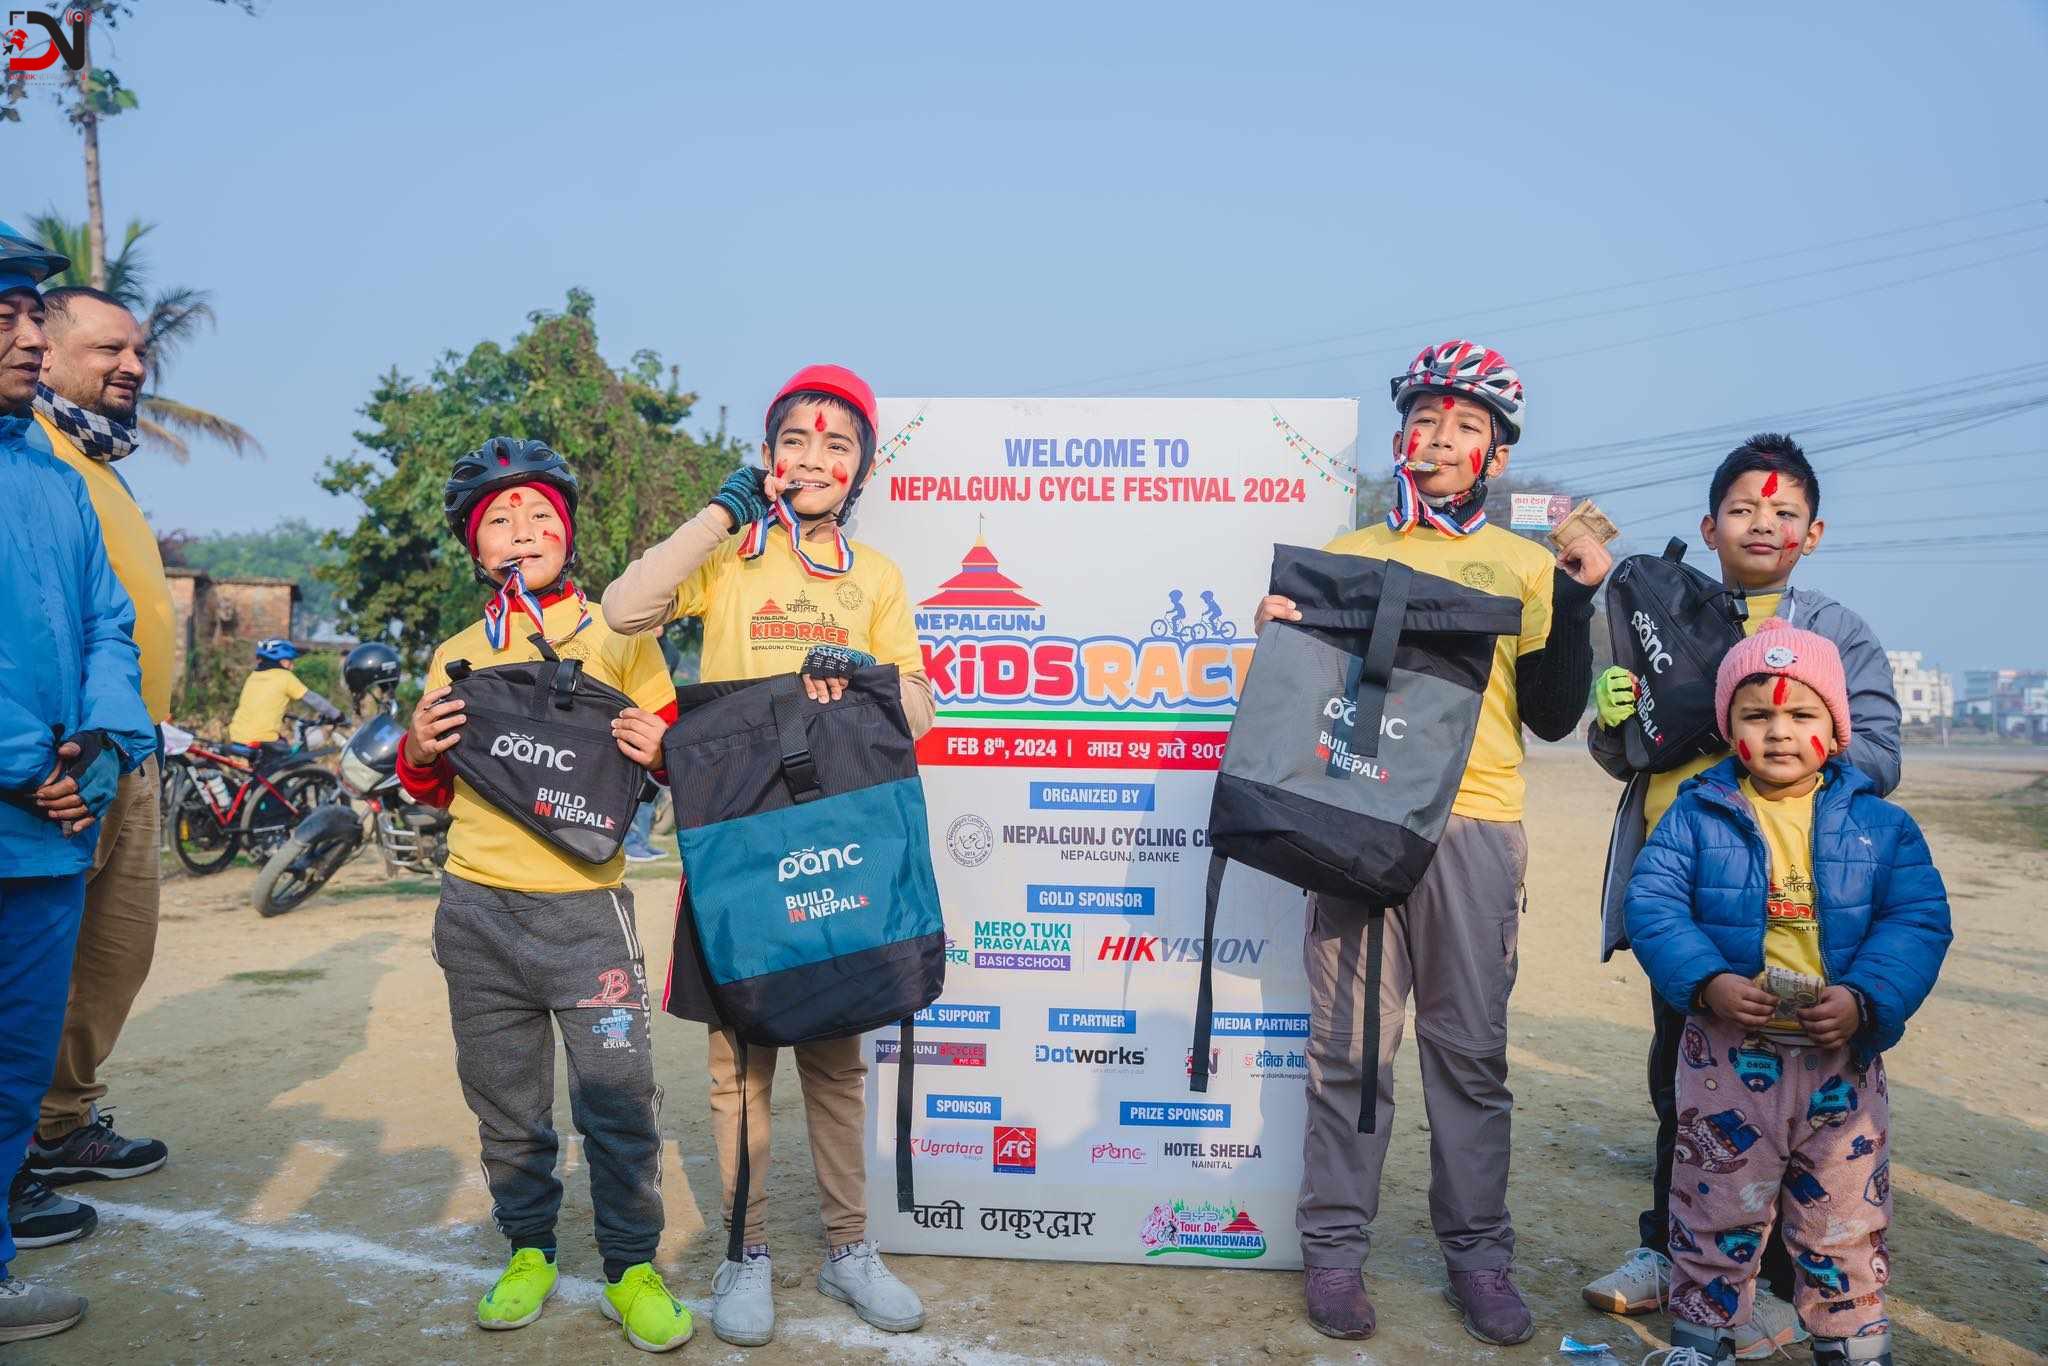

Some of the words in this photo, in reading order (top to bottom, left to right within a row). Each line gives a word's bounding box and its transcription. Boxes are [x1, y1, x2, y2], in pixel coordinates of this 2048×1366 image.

[1005, 438, 1146, 468] WELCOME
[1154, 439, 1189, 468] TO
[890, 476, 1030, 502] NEPALGUNJ
[1040, 477, 1114, 502] CYCLE
[1124, 477, 1236, 502] FESTIVAL
[1243, 478, 1305, 503] 2024
[914, 613, 1046, 631] NEPALGUNJ
[750, 622, 796, 639] KIDS
[797, 624, 848, 645] RACE
[948, 738, 979, 756] FEB
[984, 738, 1010, 760] 8th,
[1014, 739, 1057, 757] 2024
[1087, 741, 1123, 758] माघ
[1128, 743, 1150, 759] २५
[1158, 738, 1186, 759] गते
[1192, 743, 1226, 759] २०८
[1320, 730, 1360, 759] BUIL
[1331, 752, 1380, 780] NEPAL
[537, 787, 586, 809] BUILD
[1043, 788, 1118, 804] ORGANIZED
[1122, 789, 1140, 804] BY
[534, 800, 553, 818] IN
[554, 805, 606, 828] NEPAL
[1003, 825, 1105, 845] NEPALGUNJ
[1112, 827, 1187, 847] CYCLING
[1193, 829, 1213, 847] CL
[1061, 850, 1135, 863] NEPALGUNJ,
[1139, 852, 1180, 863] BANKE
[785, 888, 835, 910] BUILD
[1039, 890, 1074, 906] GOLD
[1078, 892, 1143, 908] SPONSOR
[789, 907, 807, 923] IN
[808, 895, 861, 920] NEPAL
[974, 921, 1027, 937] MERO
[1031, 922, 1072, 938] TUKI
[974, 937, 1071, 952] PRAGYALAYA
[1097, 936, 1265, 964] HIKVISION
[979, 956, 1015, 967] BASIC
[1017, 957, 1066, 969] SCHOOL
[938, 1009, 991, 1023] SUPPORT
[1059, 1013, 1070, 1026] IT
[1072, 1014, 1126, 1028] PARTNER
[1214, 1017, 1252, 1030] MEDIA
[1255, 1018, 1308, 1031] PARTNER
[1035, 1044, 1145, 1065] Dotworks
[936, 1100, 992, 1114] SPONSOR
[1130, 1106, 1164, 1121] PRIZE
[1167, 1108, 1224, 1122] SPONSOR
[920, 1139, 984, 1156] Ugratara
[1000, 1140, 1031, 1159] AFG
[1164, 1142, 1206, 1158] HOTEL
[1210, 1143, 1262, 1159] SHEELA
[1192, 1160, 1233, 1170] NAINITAL
[1180, 1221, 1202, 1233] Tour
[1180, 1234, 1262, 1247] THAKURDWARA
